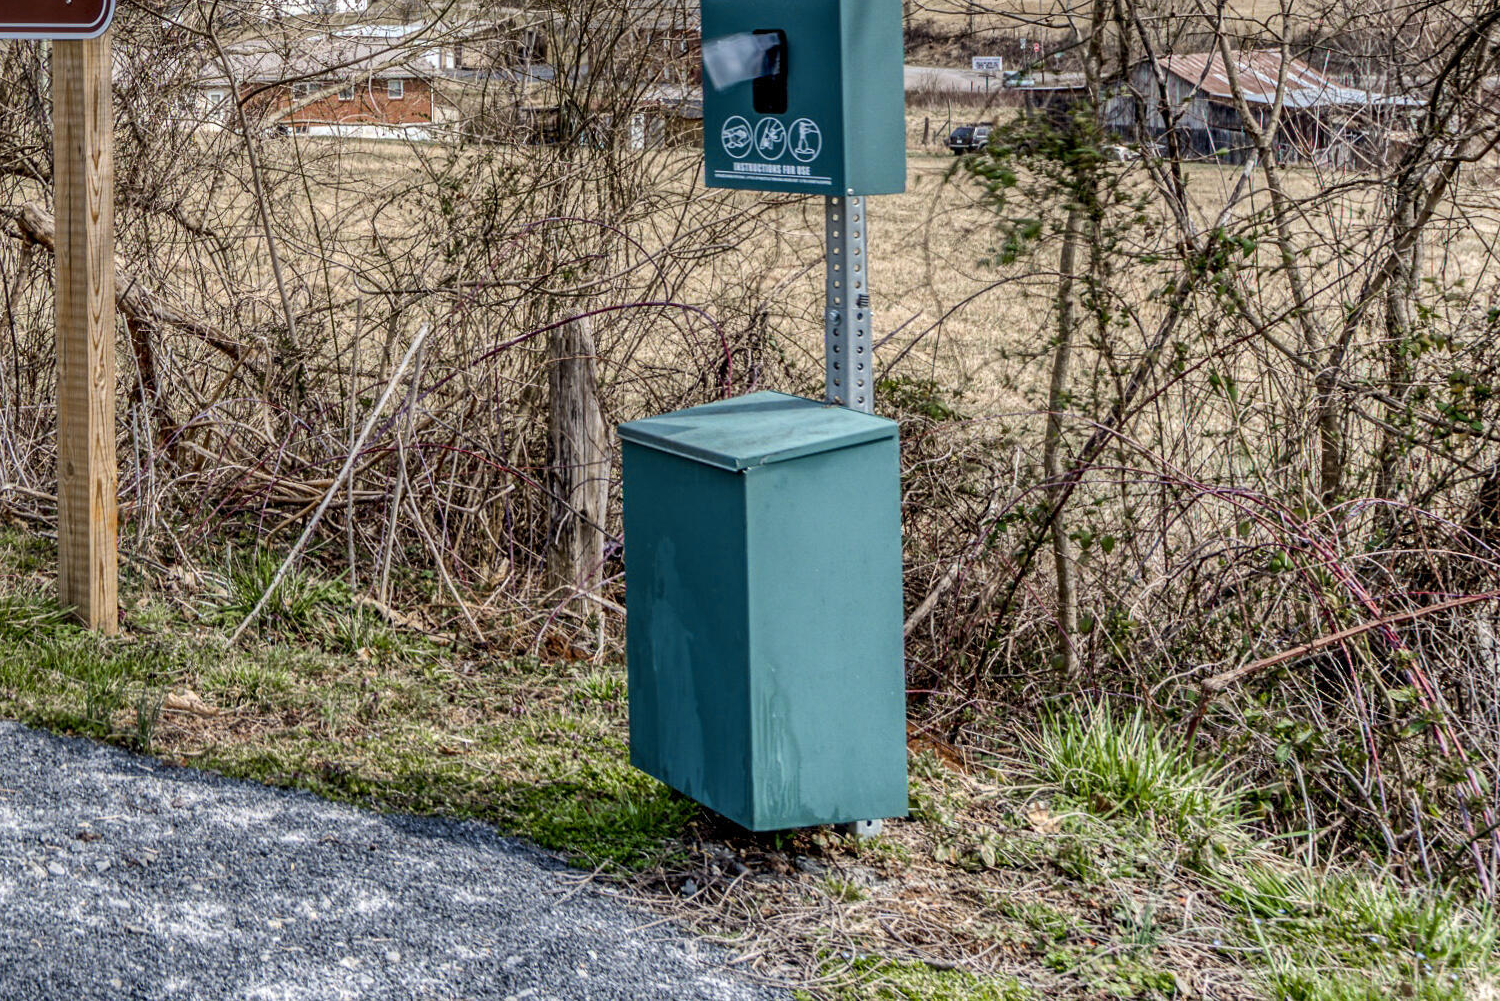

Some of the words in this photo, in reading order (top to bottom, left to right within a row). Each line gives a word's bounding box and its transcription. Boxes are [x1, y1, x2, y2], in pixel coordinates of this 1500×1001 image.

[733, 162, 781, 174] INSTRUCTIONS
[782, 164, 796, 175] FOR
[797, 165, 811, 176] USE
